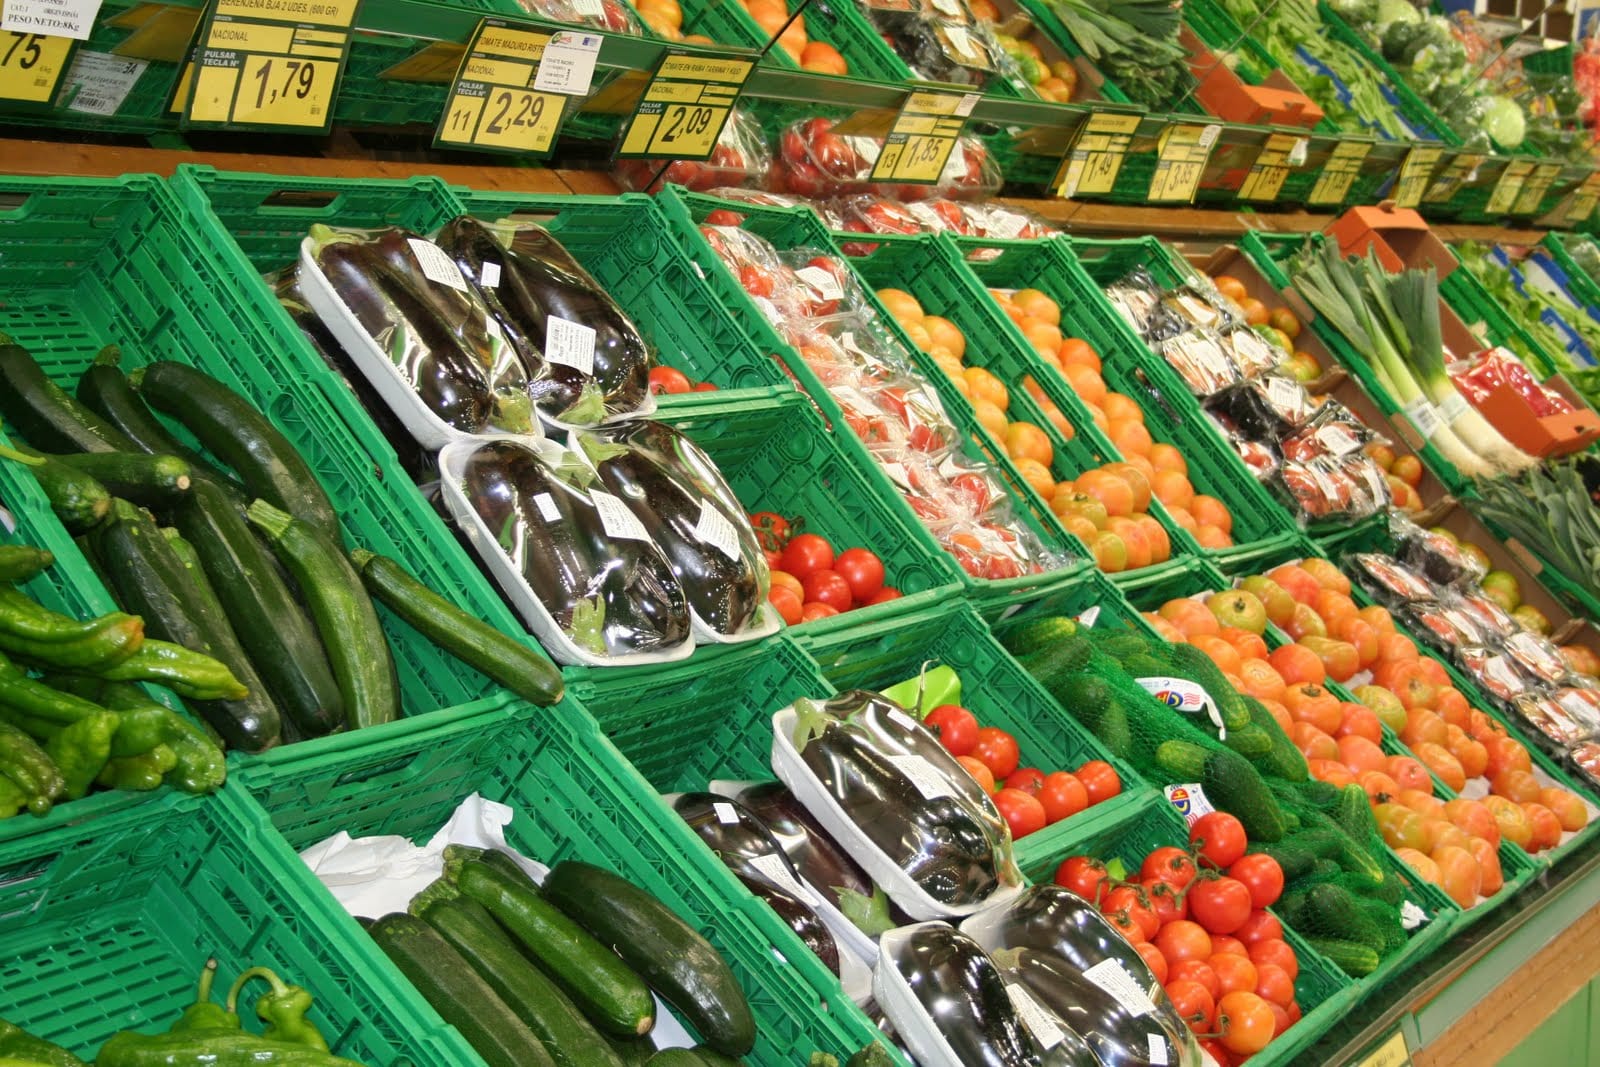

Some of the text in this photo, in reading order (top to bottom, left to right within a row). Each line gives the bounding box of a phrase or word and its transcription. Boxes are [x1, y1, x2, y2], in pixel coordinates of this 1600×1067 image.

[221, 0, 265, 9] BERENJENA
[8, 14, 32, 24] PESO
[211, 29, 249, 42] NACIONAL
[502, 39, 527, 51] MADURO
[204, 50, 237, 59] PULSAR
[203, 58, 229, 67] TECLA
[466, 63, 496, 77] NACIONAL
[255, 59, 315, 109] 1,79
[458, 82, 485, 90] PULSAR
[456, 88, 479, 96] TECLA
[486, 91, 545, 135] 2,29
[452, 110, 472, 131] 11
[661, 106, 713, 143] 2,09
[906, 138, 944, 169] 1,85
[882, 153, 896, 169] 13
